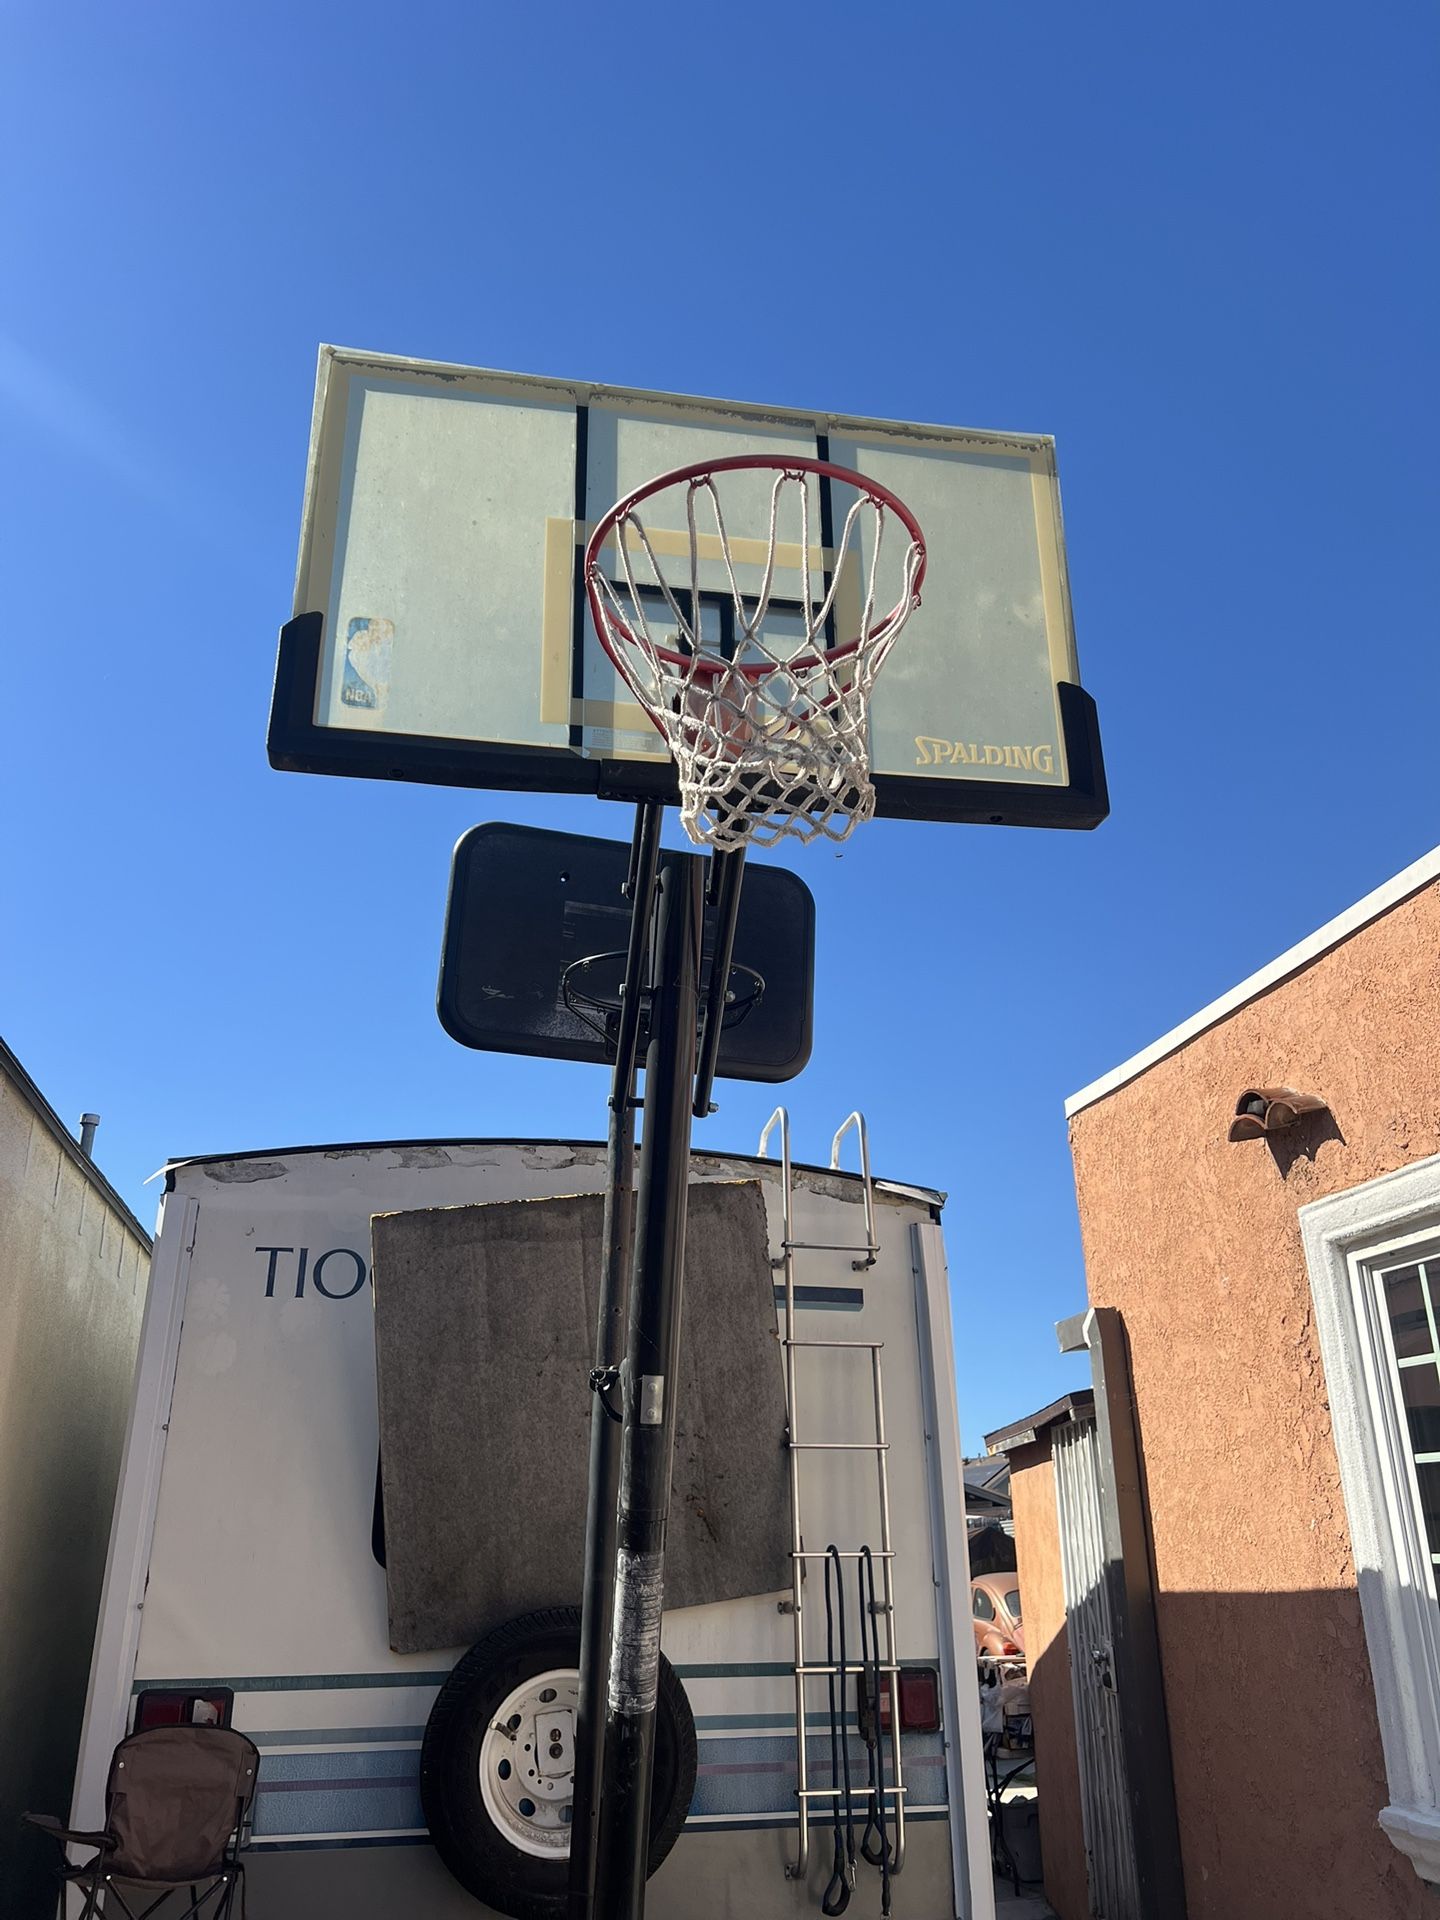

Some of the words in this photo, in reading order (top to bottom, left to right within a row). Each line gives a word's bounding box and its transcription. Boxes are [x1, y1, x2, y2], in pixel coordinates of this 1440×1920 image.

[345, 687, 371, 704] NBA
[914, 735, 1054, 775] SPALDING
[255, 1246, 373, 1300] TIO
